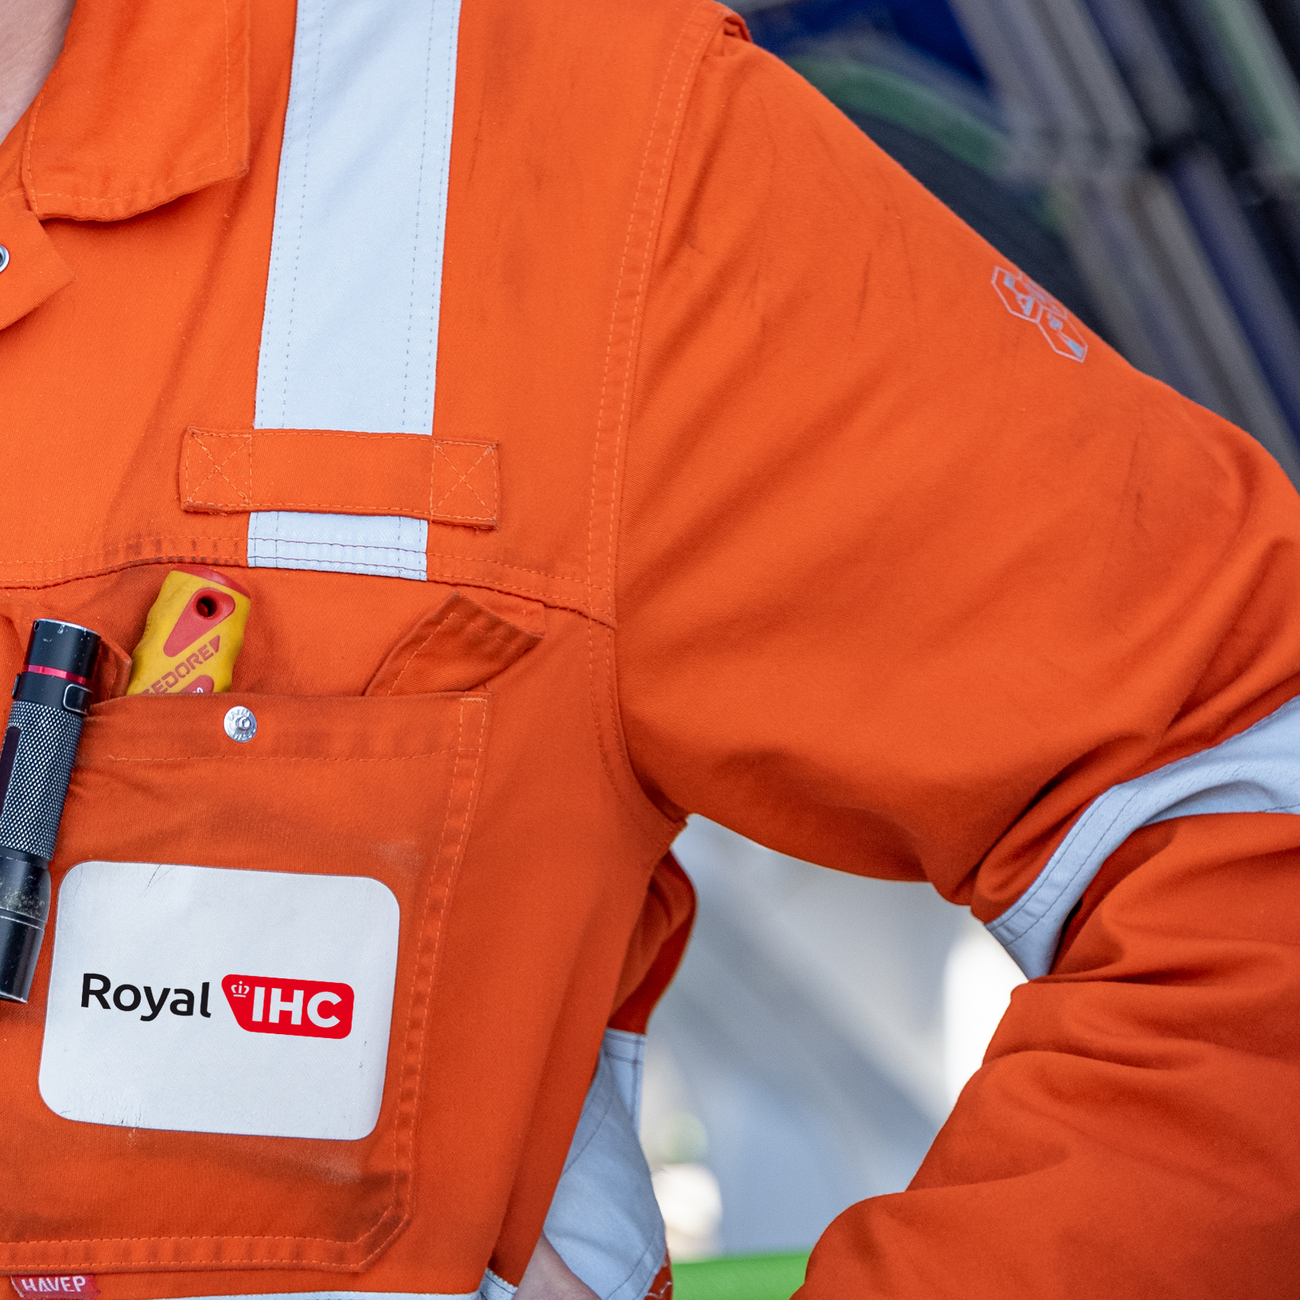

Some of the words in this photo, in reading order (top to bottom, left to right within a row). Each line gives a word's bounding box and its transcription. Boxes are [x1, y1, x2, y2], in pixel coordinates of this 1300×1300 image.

[80, 973, 211, 1022] Royal
[252, 986, 342, 1028] IHC
[21, 1275, 86, 1293] HAVEP
